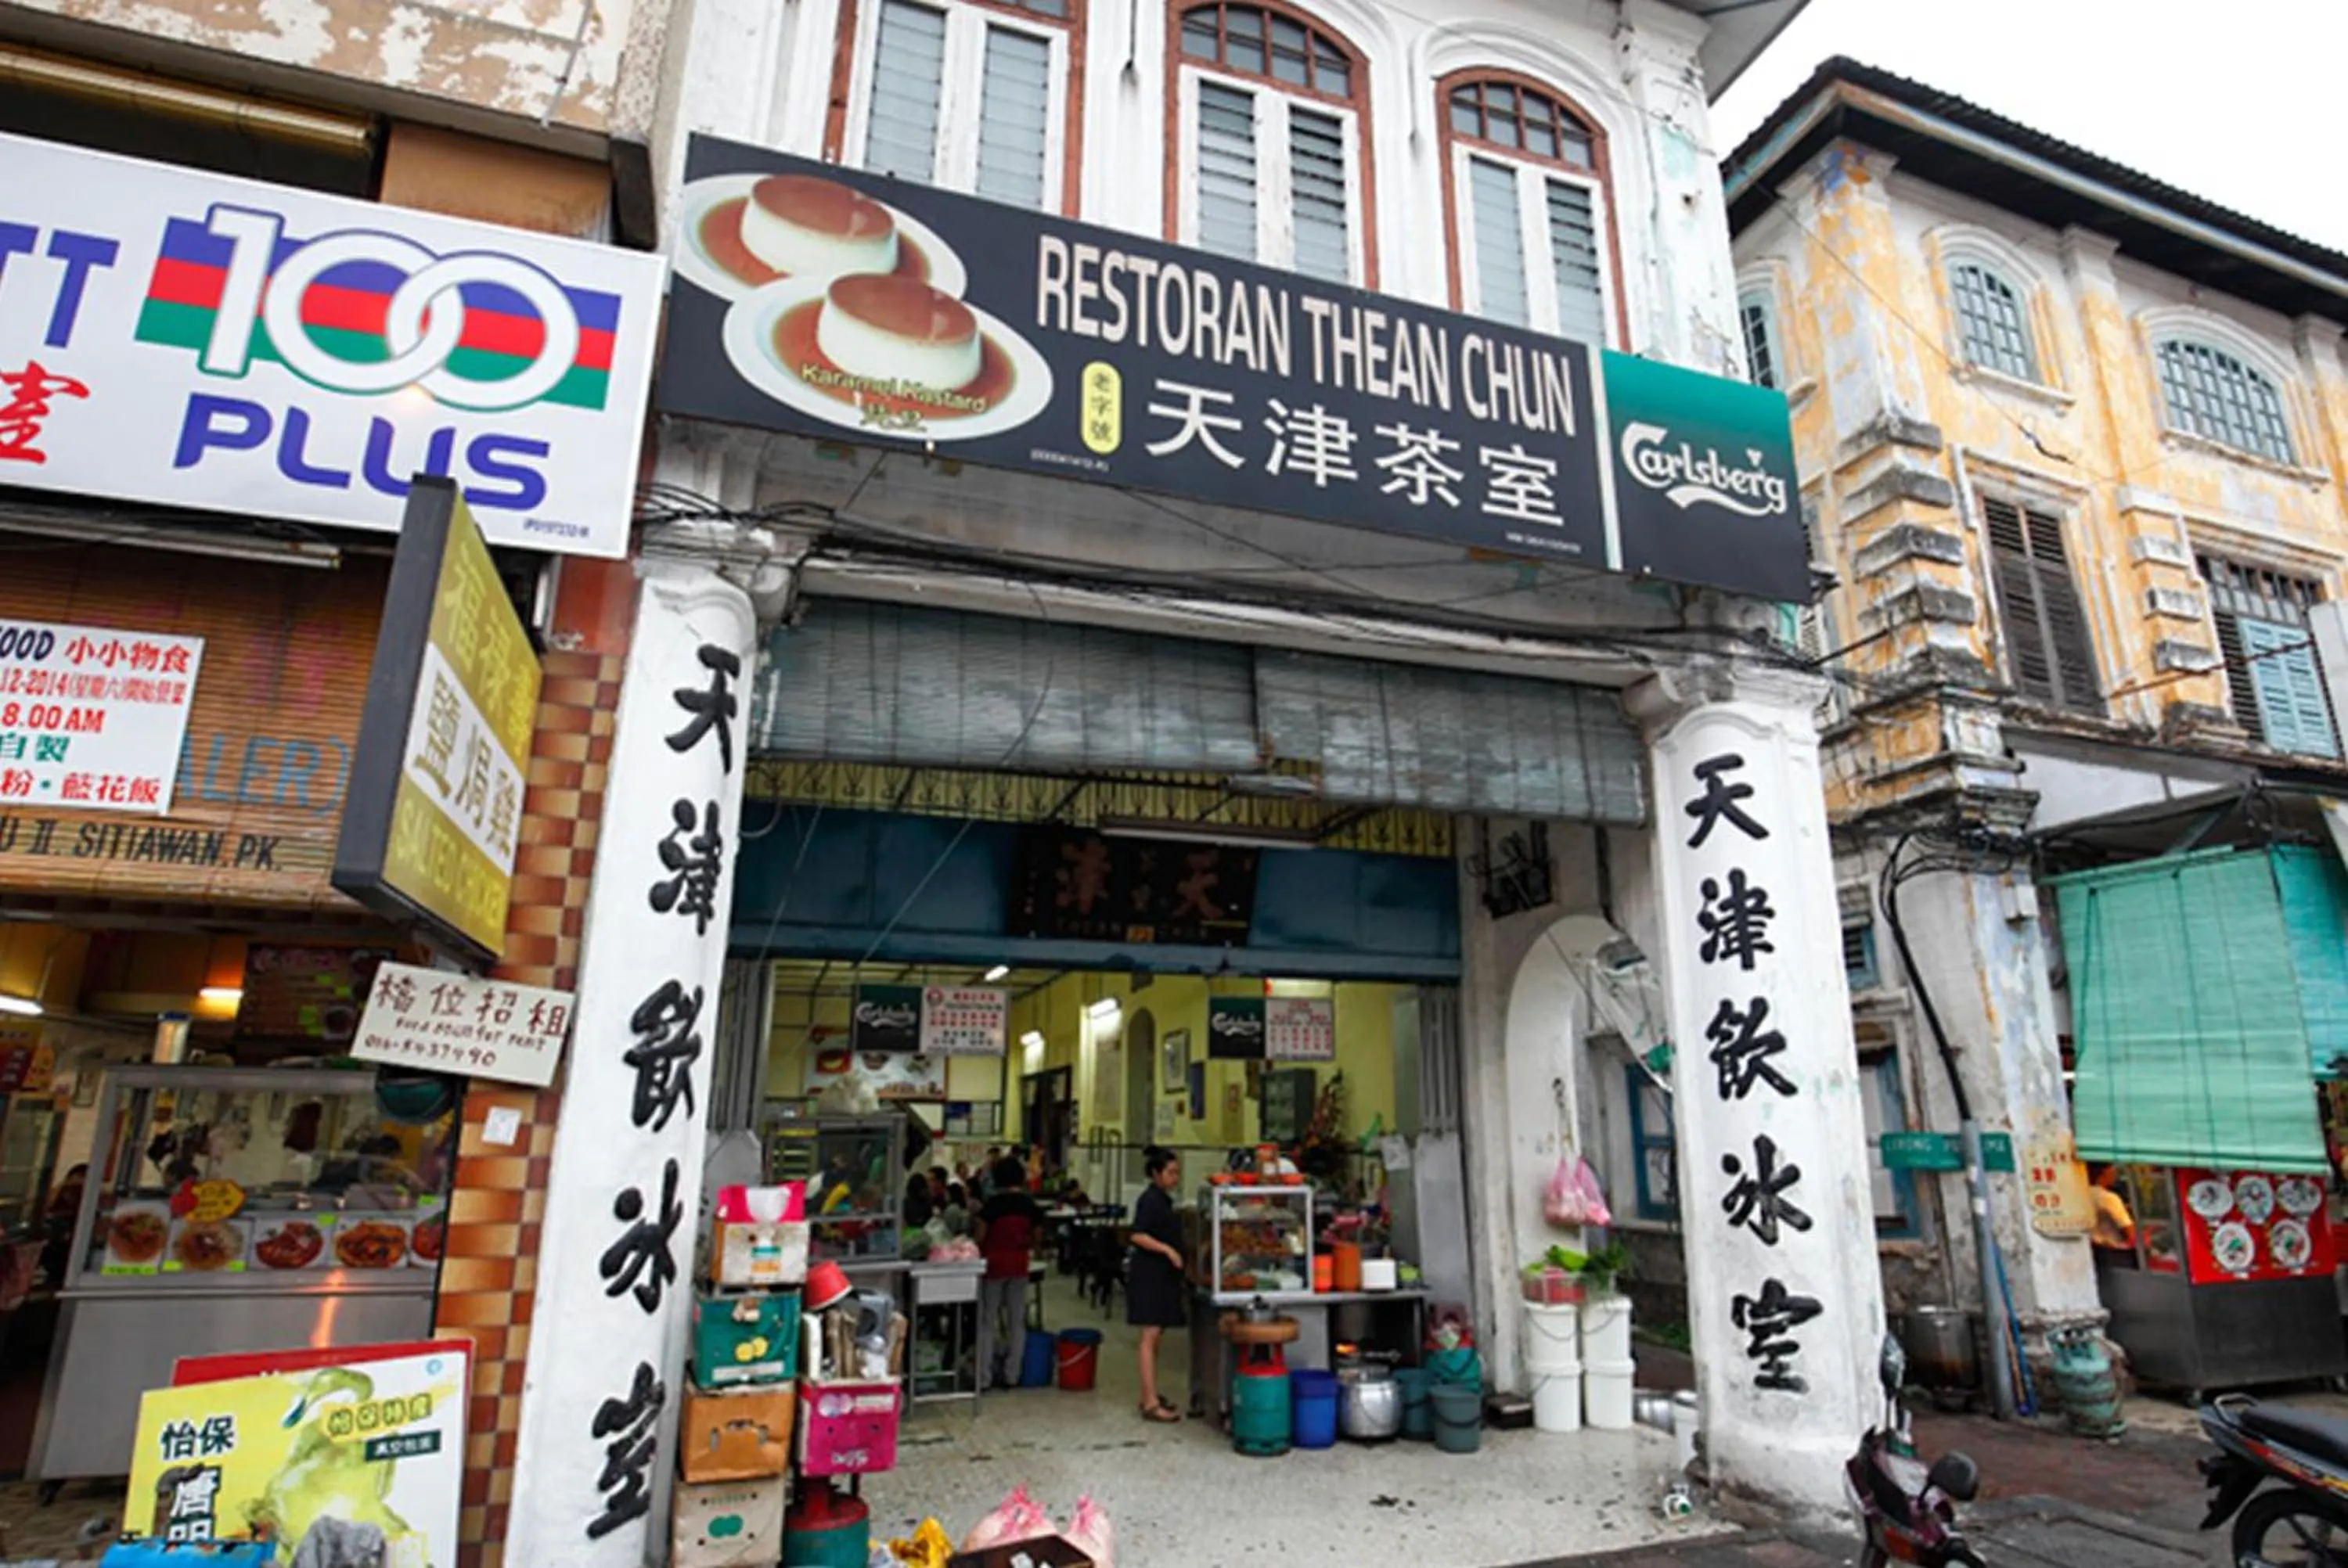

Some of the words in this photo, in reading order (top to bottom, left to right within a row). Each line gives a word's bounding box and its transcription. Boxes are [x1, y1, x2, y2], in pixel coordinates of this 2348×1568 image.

[198, 203, 580, 411] 100
[1037, 235, 1291, 377] RESTORAN
[1302, 296, 1451, 411] THEAN
[1462, 333, 1576, 437] CHUN
[801, 362, 898, 394] Karamel
[173, 392, 551, 510] PLUS
[1145, 377, 1565, 527] 天津茶室
[1621, 420, 1787, 516] Carlsberg
[0, 628, 55, 661] OOD
[64, 635, 190, 674] 小小物食
[160, 1415, 235, 1459] 怡保
